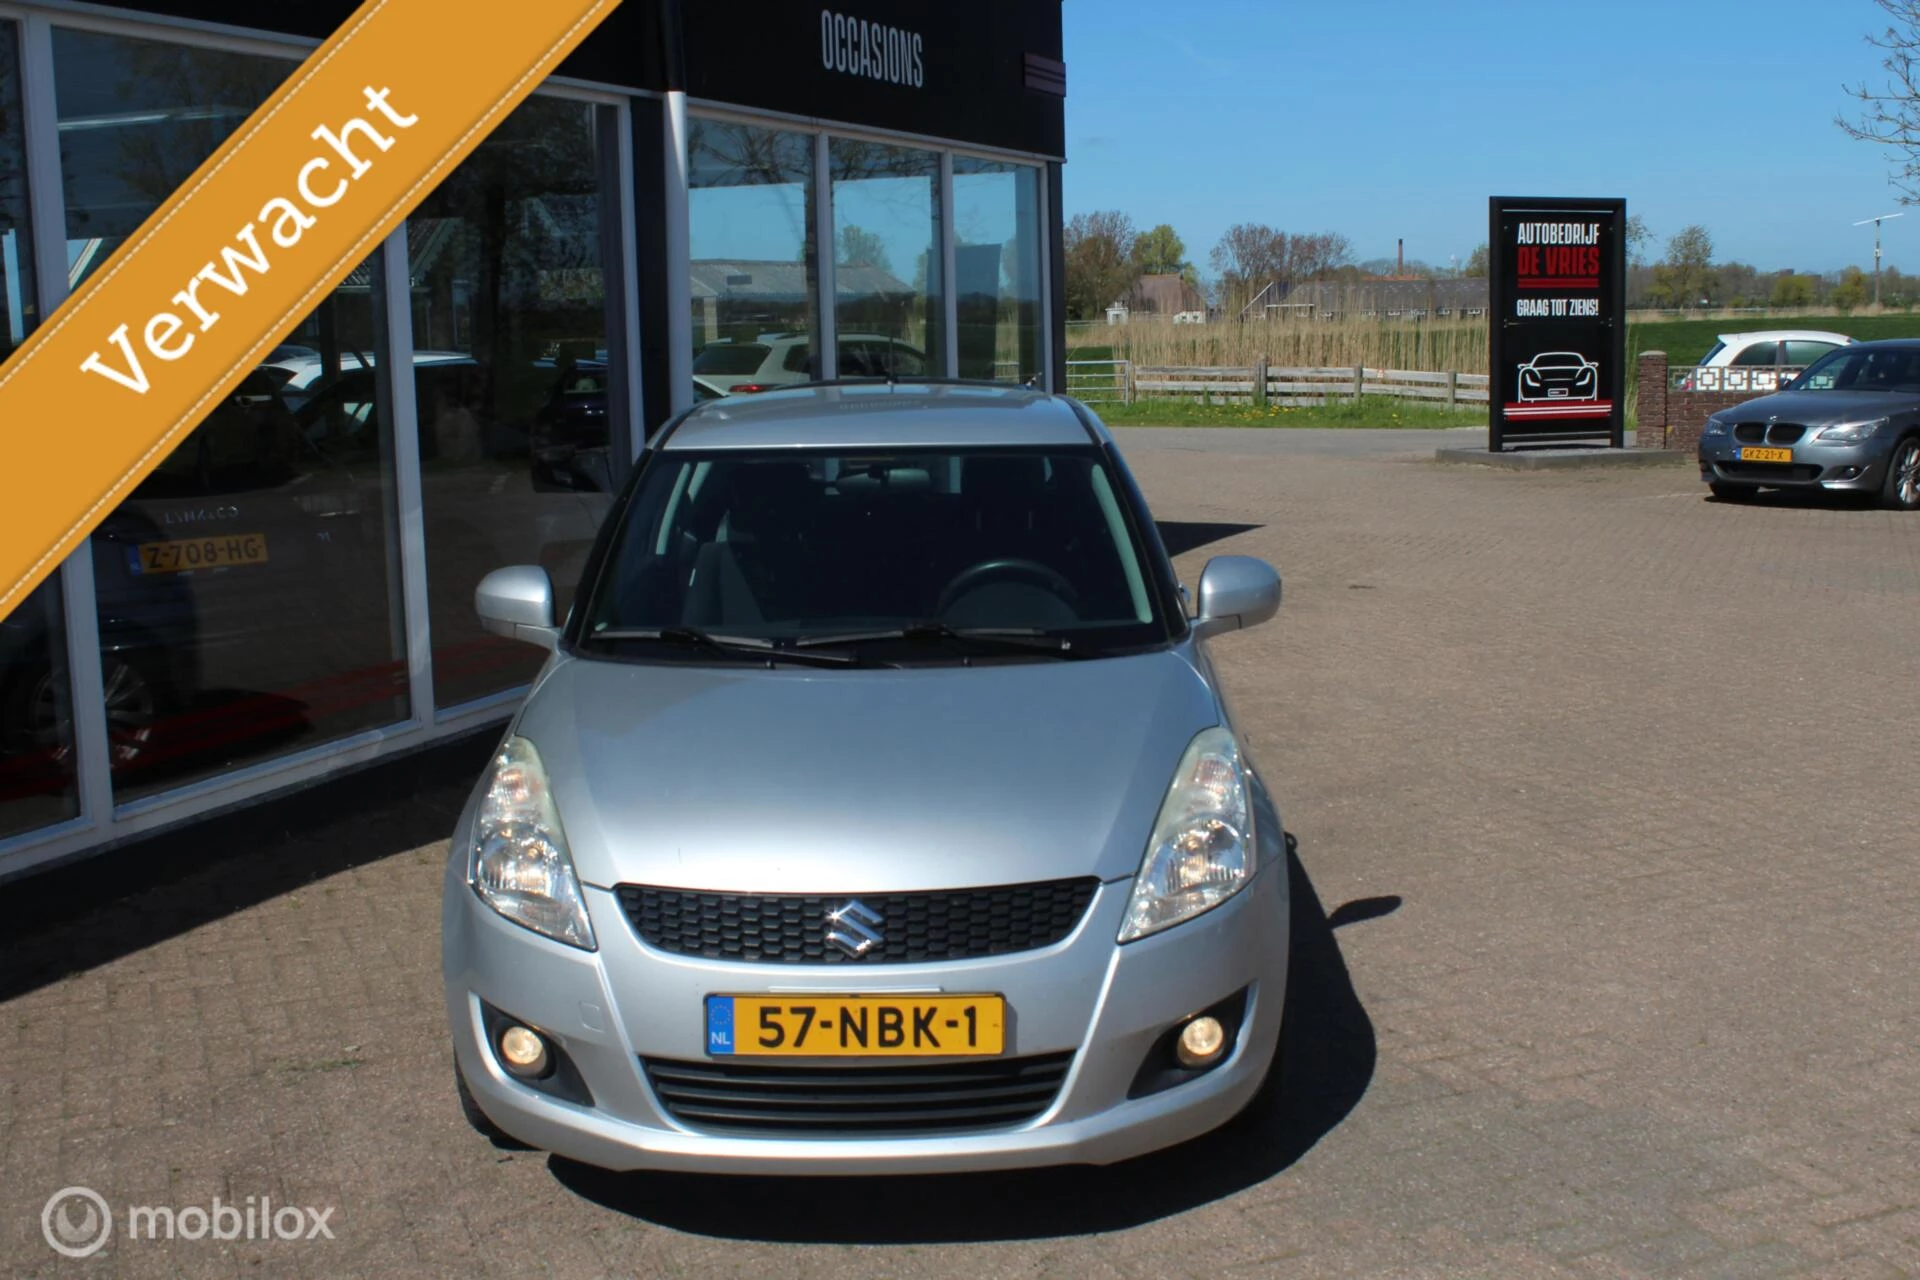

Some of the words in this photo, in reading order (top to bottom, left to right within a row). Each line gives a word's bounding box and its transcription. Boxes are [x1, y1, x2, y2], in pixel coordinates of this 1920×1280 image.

[821, 9, 924, 88] OCCASIONS
[1517, 222, 1600, 245] AUTOBEDRIJF
[1517, 247, 1540, 275] DE
[1545, 247, 1600, 275] VRIES
[1517, 299, 1549, 316] GRAAG
[1550, 299, 1566, 316] TOT
[1569, 299, 1599, 316] ZIENS!
[711, 1031, 731, 1045] NL
[758, 1006, 977, 1048] 57-NBK-1
